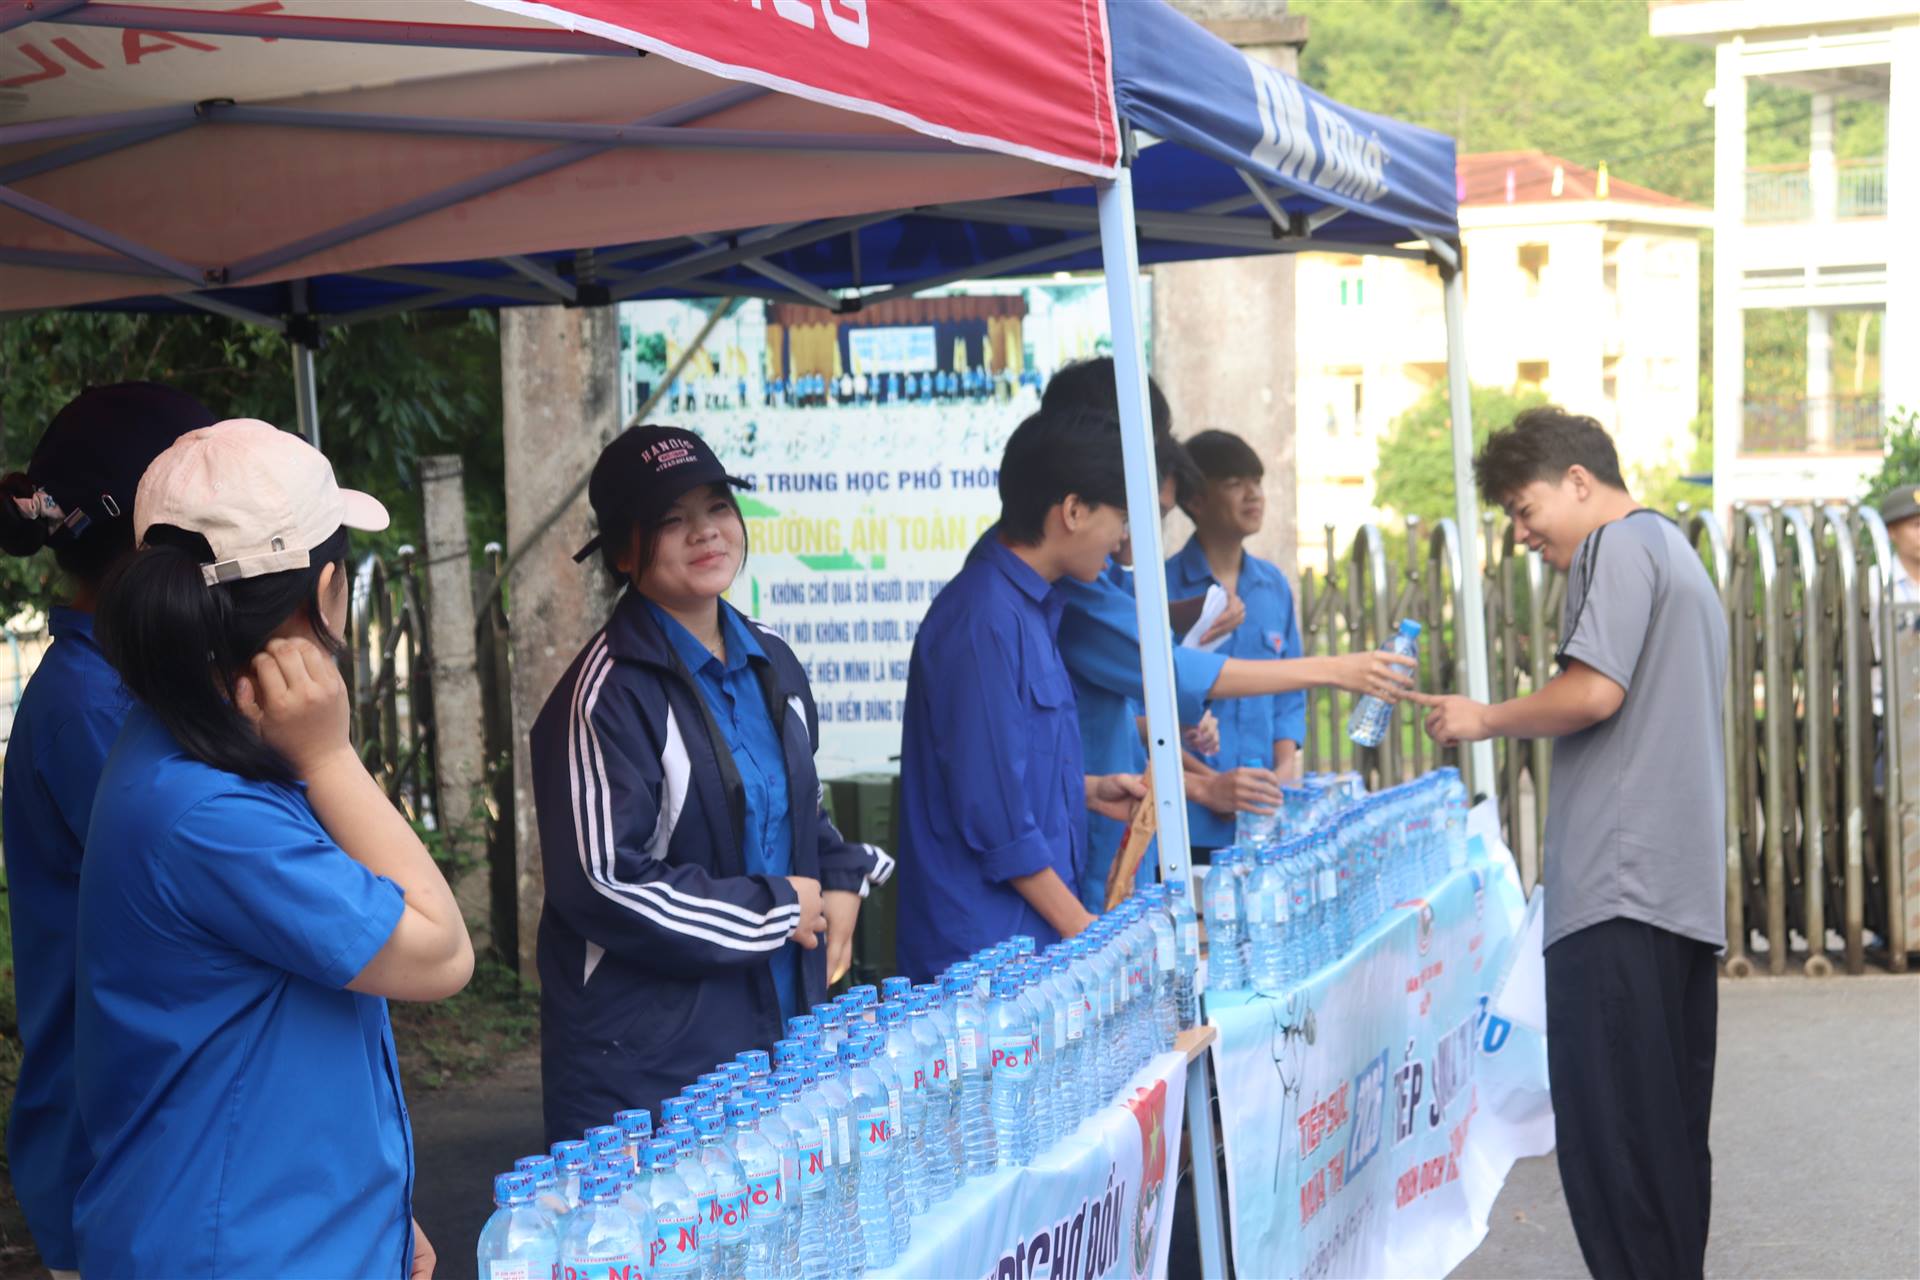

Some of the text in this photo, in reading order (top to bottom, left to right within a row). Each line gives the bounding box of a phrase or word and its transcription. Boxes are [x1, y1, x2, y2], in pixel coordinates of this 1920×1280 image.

[767, 472, 838, 492] TRUNG
[846, 471, 890, 496] HỌC
[899, 508, 967, 551] TOÀN
[771, 578, 804, 604] KHÔNG
[815, 619, 849, 643] KHÔNG
